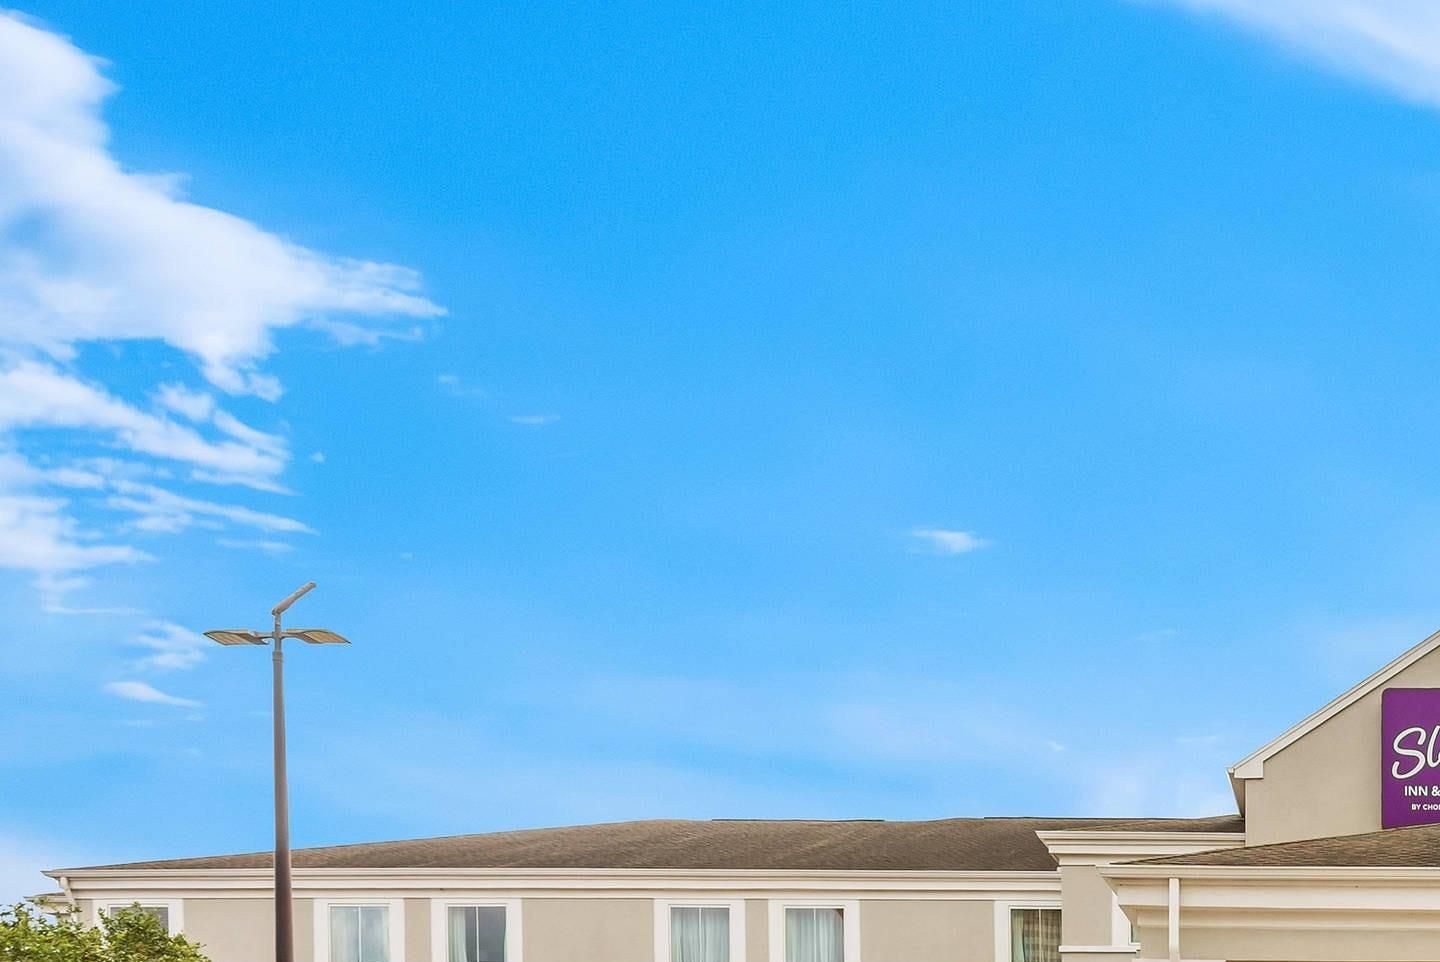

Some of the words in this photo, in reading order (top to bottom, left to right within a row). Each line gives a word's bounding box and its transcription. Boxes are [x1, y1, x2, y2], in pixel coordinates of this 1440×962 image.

[1404, 785, 1428, 797] INN
[1431, 785, 1440, 797] &
[1411, 803, 1422, 811] BY
